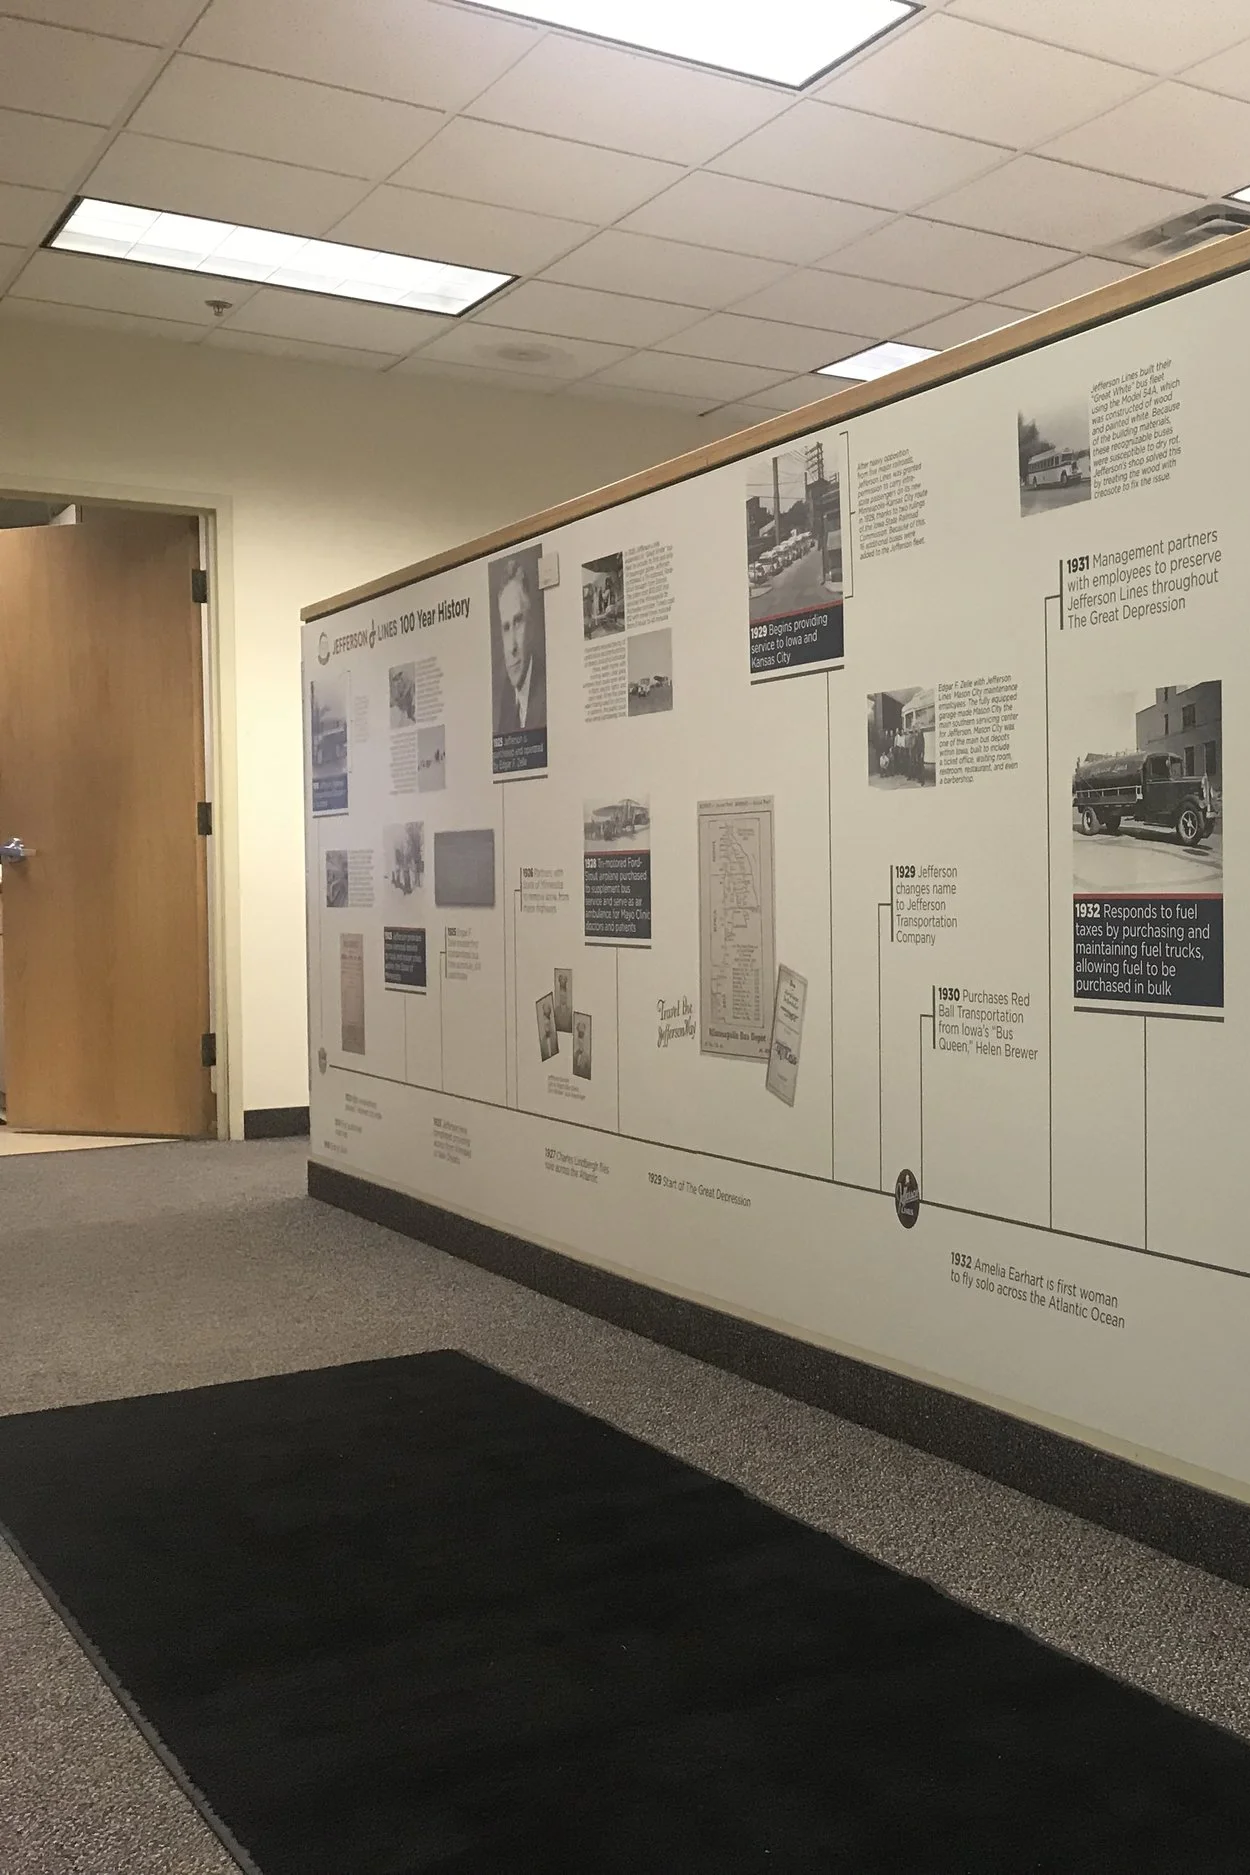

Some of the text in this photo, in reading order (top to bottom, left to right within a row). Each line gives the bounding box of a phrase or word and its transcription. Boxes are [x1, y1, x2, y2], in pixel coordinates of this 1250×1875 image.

[1067, 530, 1218, 573] 1931 Management partners
[1068, 550, 1221, 592] with employees to preserve
[1068, 568, 1218, 611] Jefferson Lines throughout
[1068, 597, 1185, 629] The Great Depression
[333, 598, 470, 655] JEFFERSON LINES 100 Year History
[751, 614, 828, 639] 1929 Begins providing
[751, 629, 818, 654] service to Iowa and
[752, 652, 791, 668] Kansas City
[896, 865, 957, 878] 1929 Jefferson
[896, 883, 956, 896] changes name
[896, 899, 945, 911] to Jefferson
[1075, 903, 1198, 921] 1932 Responds to fuel
[896, 914, 957, 929] Transportation
[1076, 922, 1210, 941] taxes by purchasing and
[896, 931, 935, 945] Company
[1076, 940, 1204, 961] maintaining fuel trucks,
[939, 988, 1030, 1006] 1930 Purchases Red
[939, 1005, 1023, 1023] Ball Transportation
[939, 1021, 1013, 1040] from Iowa's "Bus
[939, 1038, 1038, 1060] Queen," Helen Brewer
[648, 1172, 751, 1207] 1929 Start of The Great Depression
[951, 1252, 1118, 1308] 1932 Amelia Earhart is first woman
[951, 1269, 1125, 1328] to fly solo across the Atlantic Ocean
